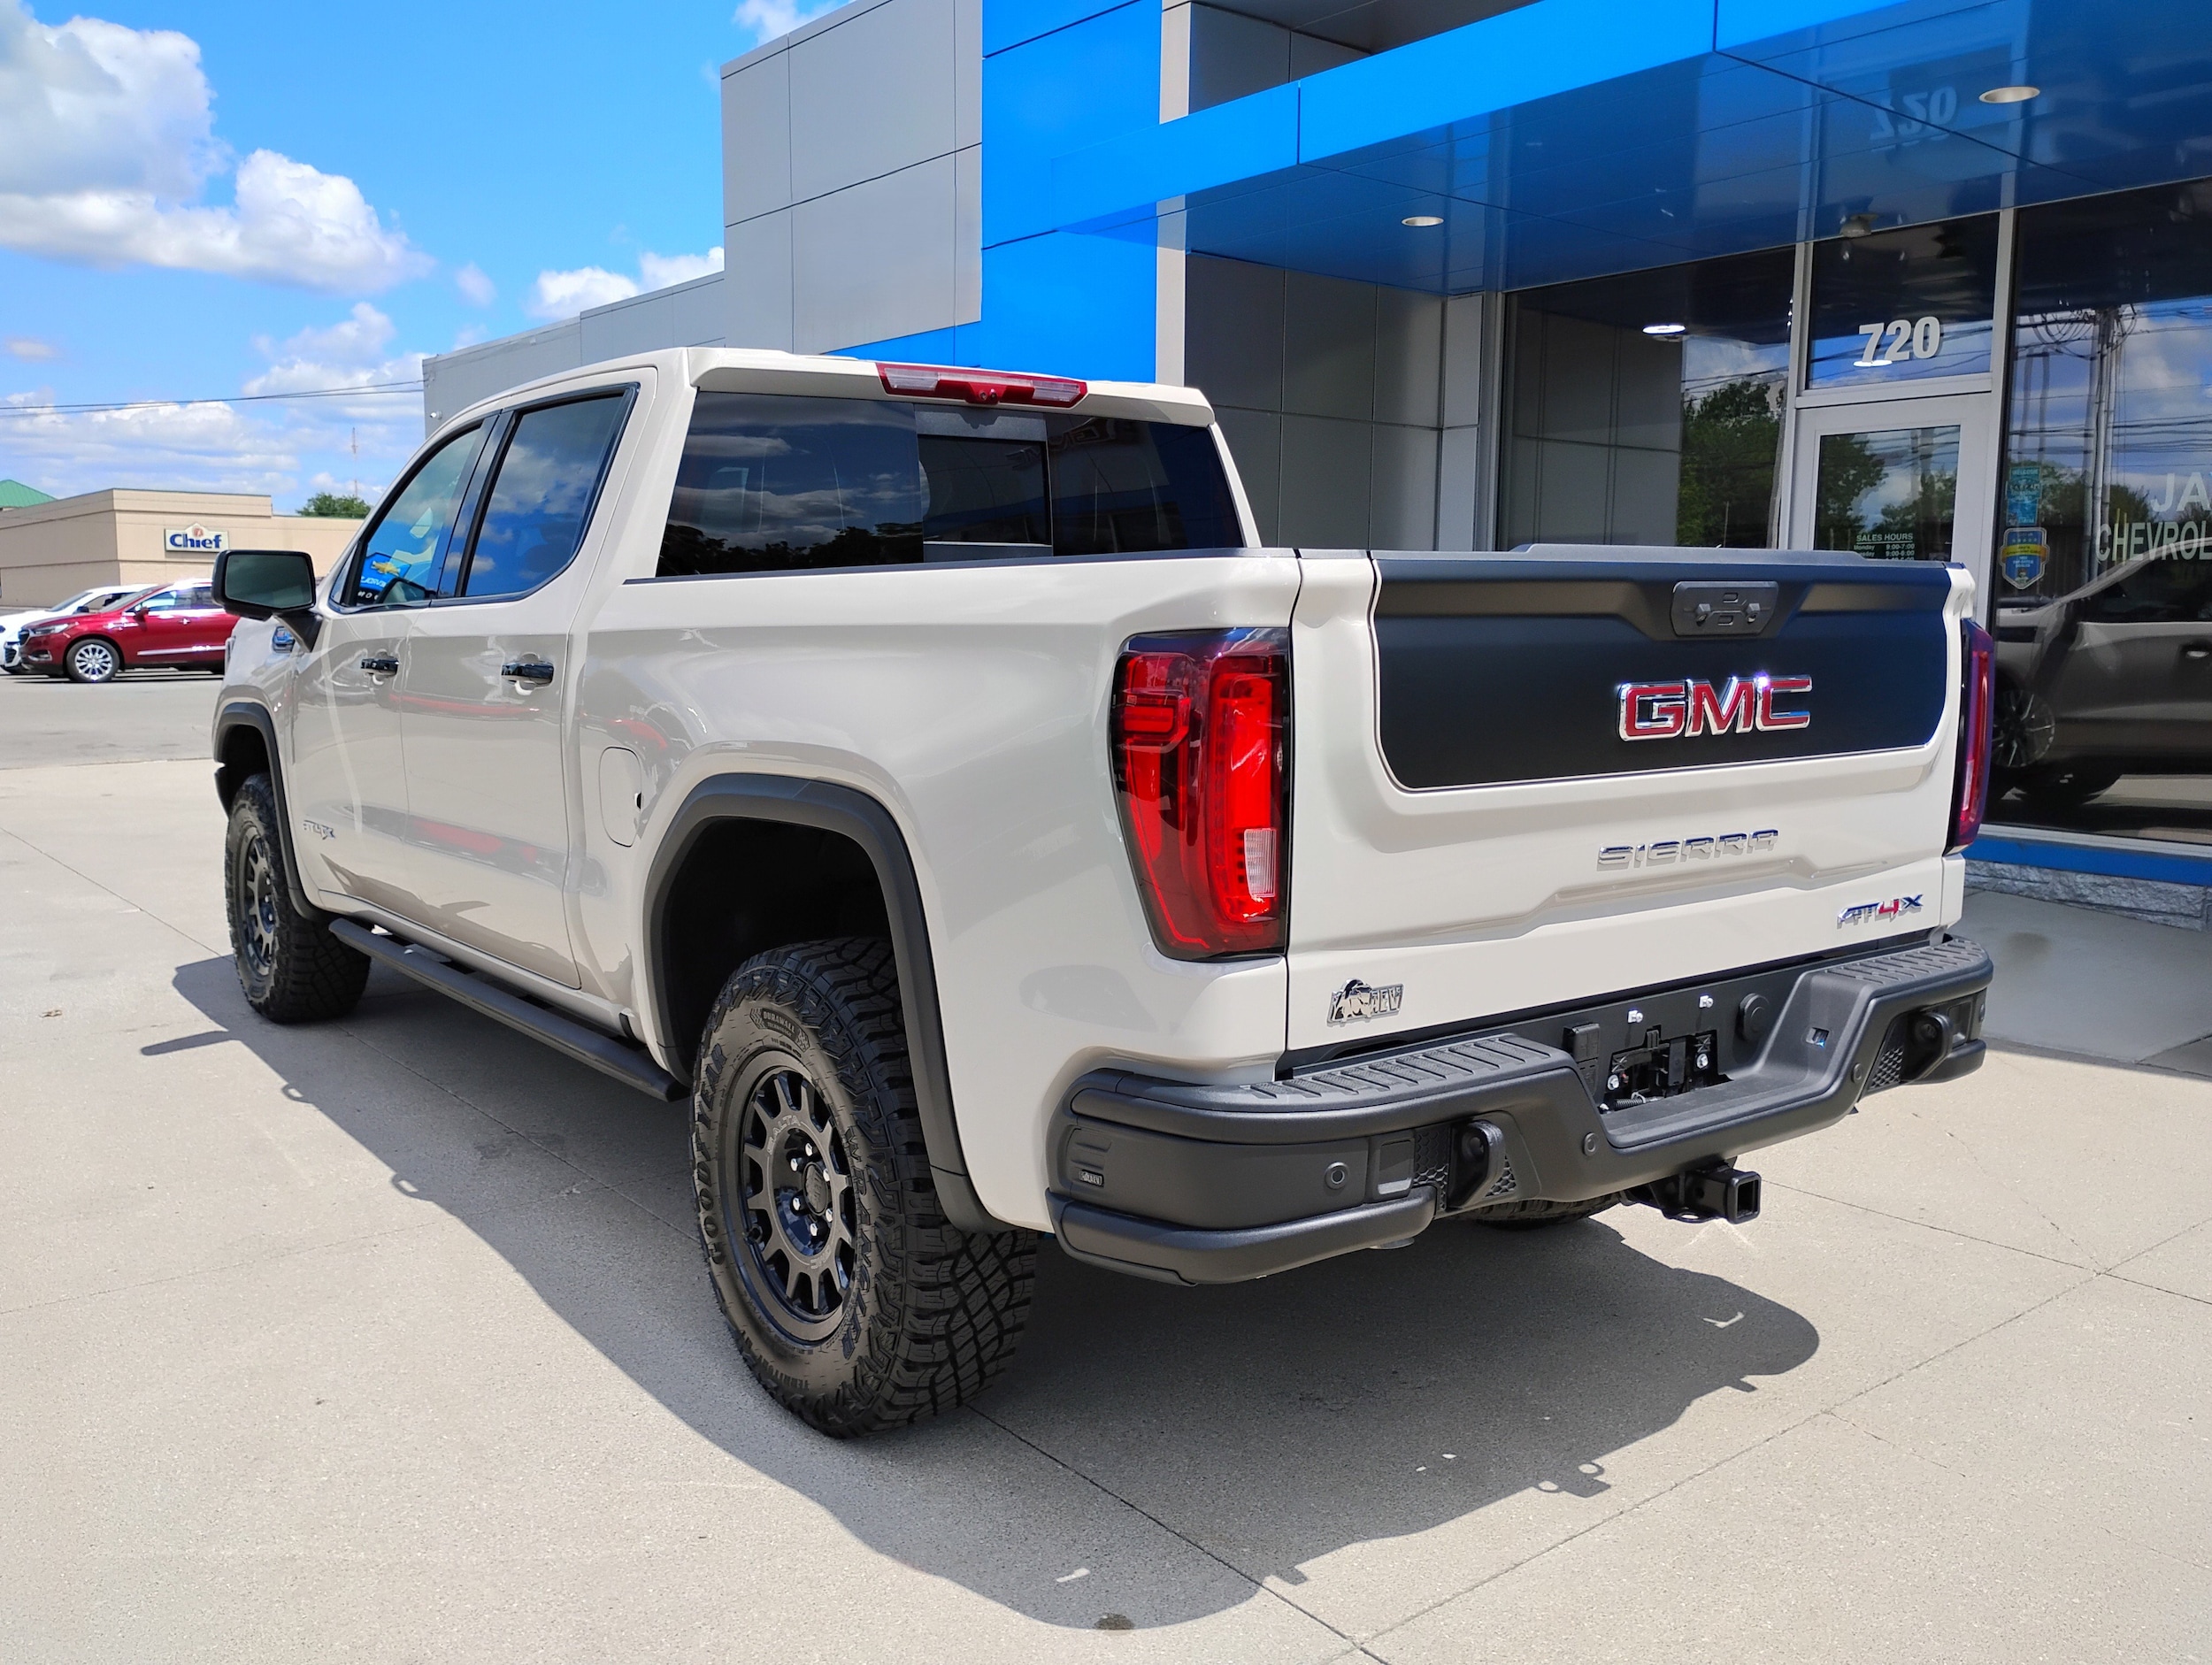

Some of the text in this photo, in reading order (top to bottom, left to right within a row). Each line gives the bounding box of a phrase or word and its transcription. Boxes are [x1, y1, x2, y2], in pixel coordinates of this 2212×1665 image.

[1859, 316, 1941, 364] 720
[2150, 472, 2212, 512] JA
[169, 533, 222, 549] Chief
[1856, 533, 1913, 542] SALES HOURS
[2096, 520, 2212, 563] CHEVROL
[1617, 673, 1813, 742] GMC
[1597, 828, 1779, 868] SIERRA
[1837, 894, 1924, 925] AT4X
[763, 1010, 795, 1034] DURAWALL
